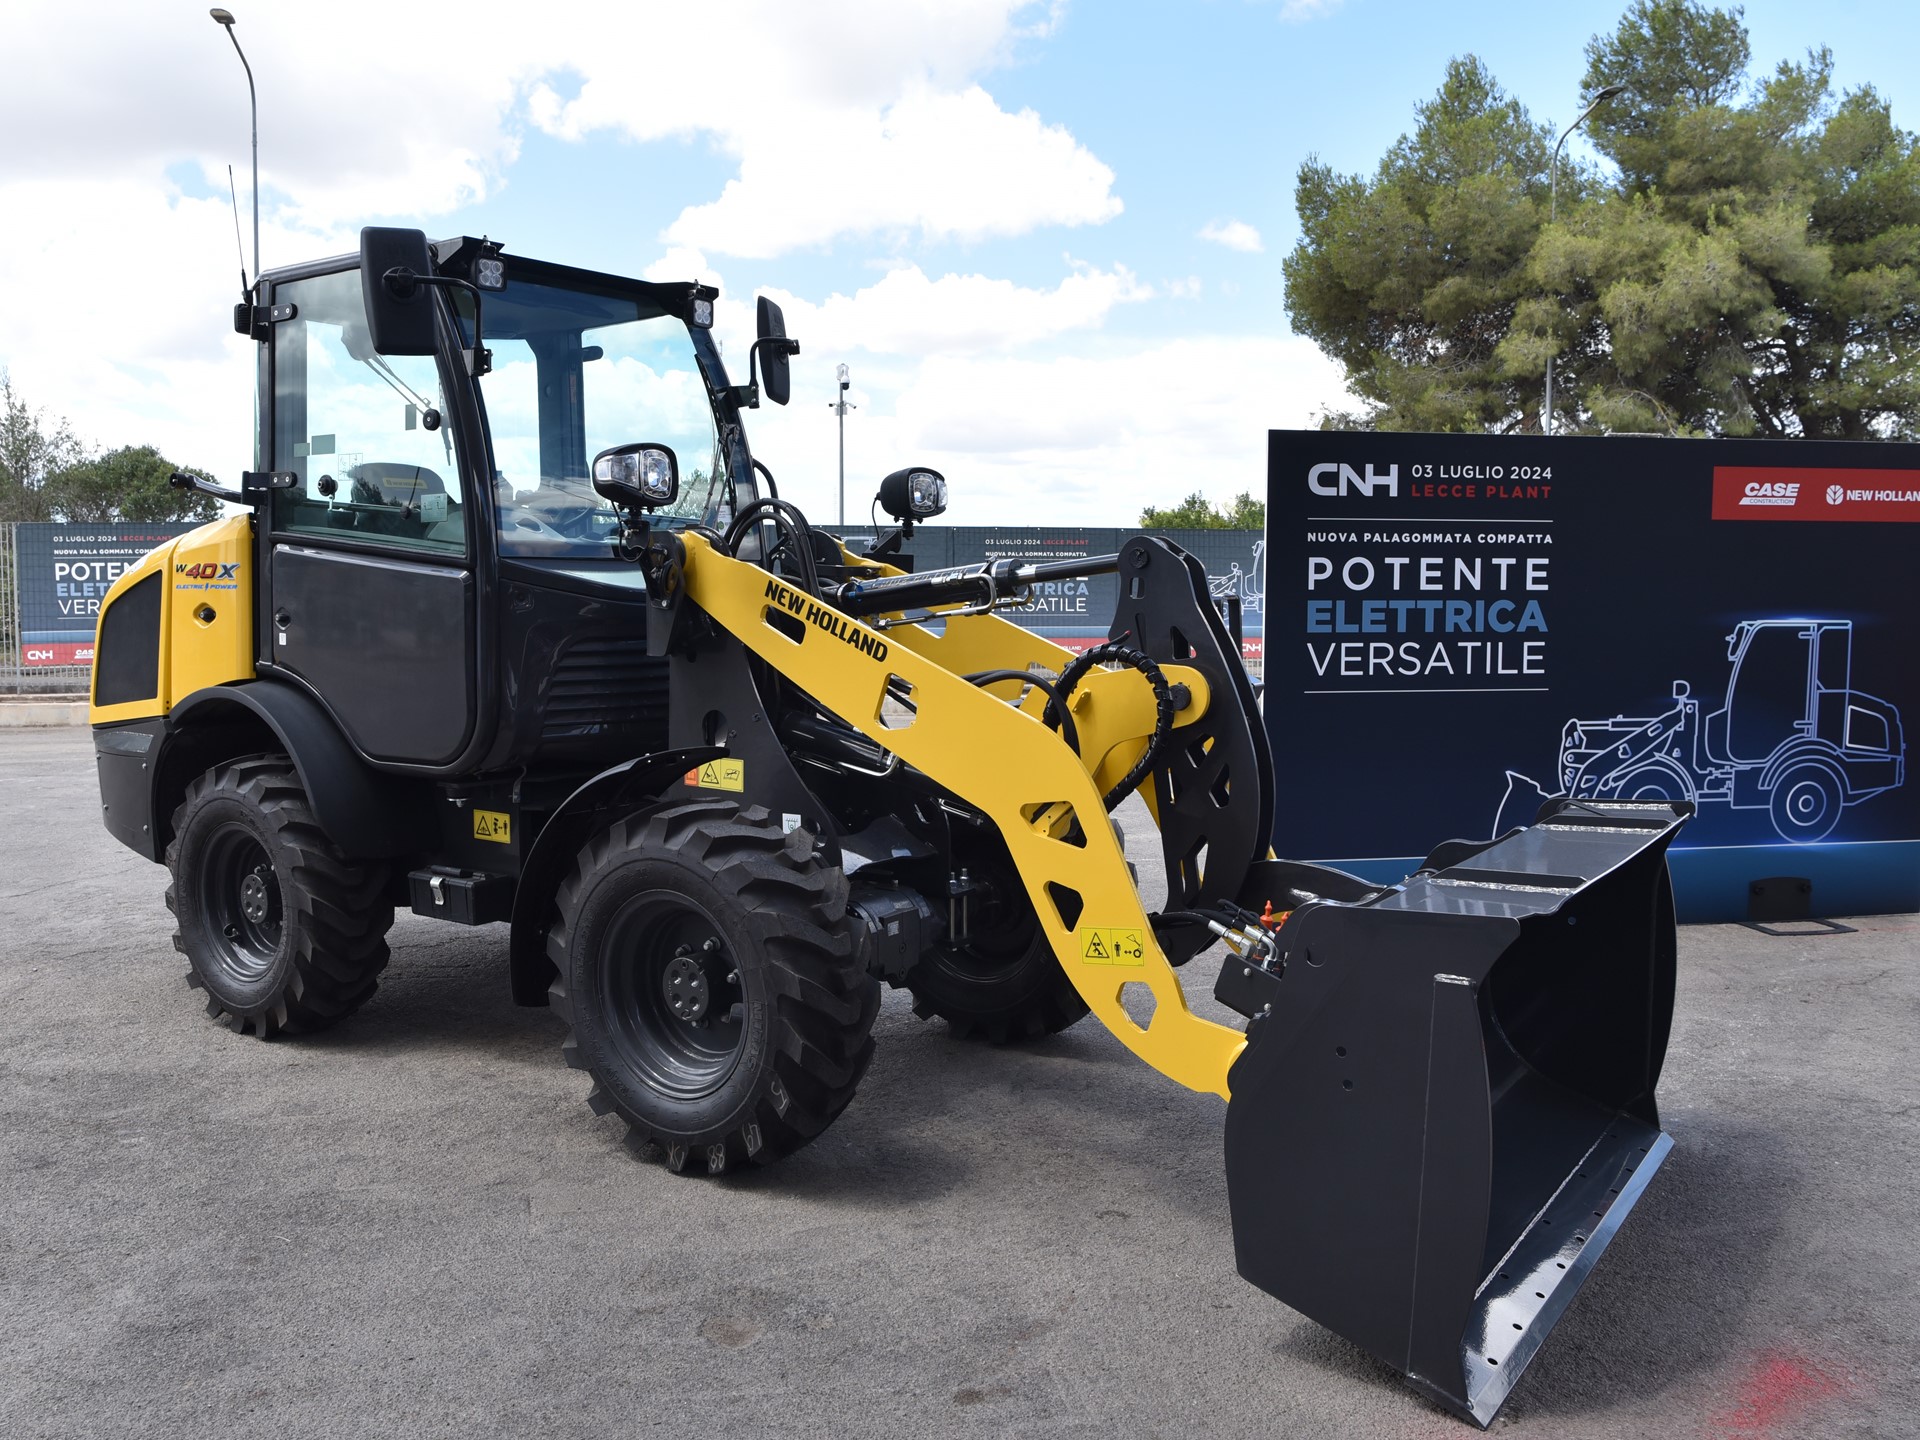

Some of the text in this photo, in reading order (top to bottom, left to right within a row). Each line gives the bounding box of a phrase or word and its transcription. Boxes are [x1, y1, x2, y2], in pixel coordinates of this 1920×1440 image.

[1307, 462, 1398, 497] CNH
[1411, 464, 1552, 480] 03 LUGLIO 2024
[1411, 484, 1552, 499] LECCE PLANT
[1744, 482, 1801, 497] CASE
[1846, 490, 1920, 502] NEW HOLLAN
[1307, 532, 1553, 544] NUOVA PALAGOMMATA COMPATTA
[1307, 556, 1550, 591] POTENTE
[56, 583, 112, 597] ELET
[1033, 582, 1089, 595] TRICA
[58, 599, 100, 615] VER
[764, 579, 888, 663] NEW HOLLAND
[1306, 599, 1549, 633] ELETTRICA
[27, 650, 54, 660] CNH
[1306, 641, 1546, 677] VERSATILE
